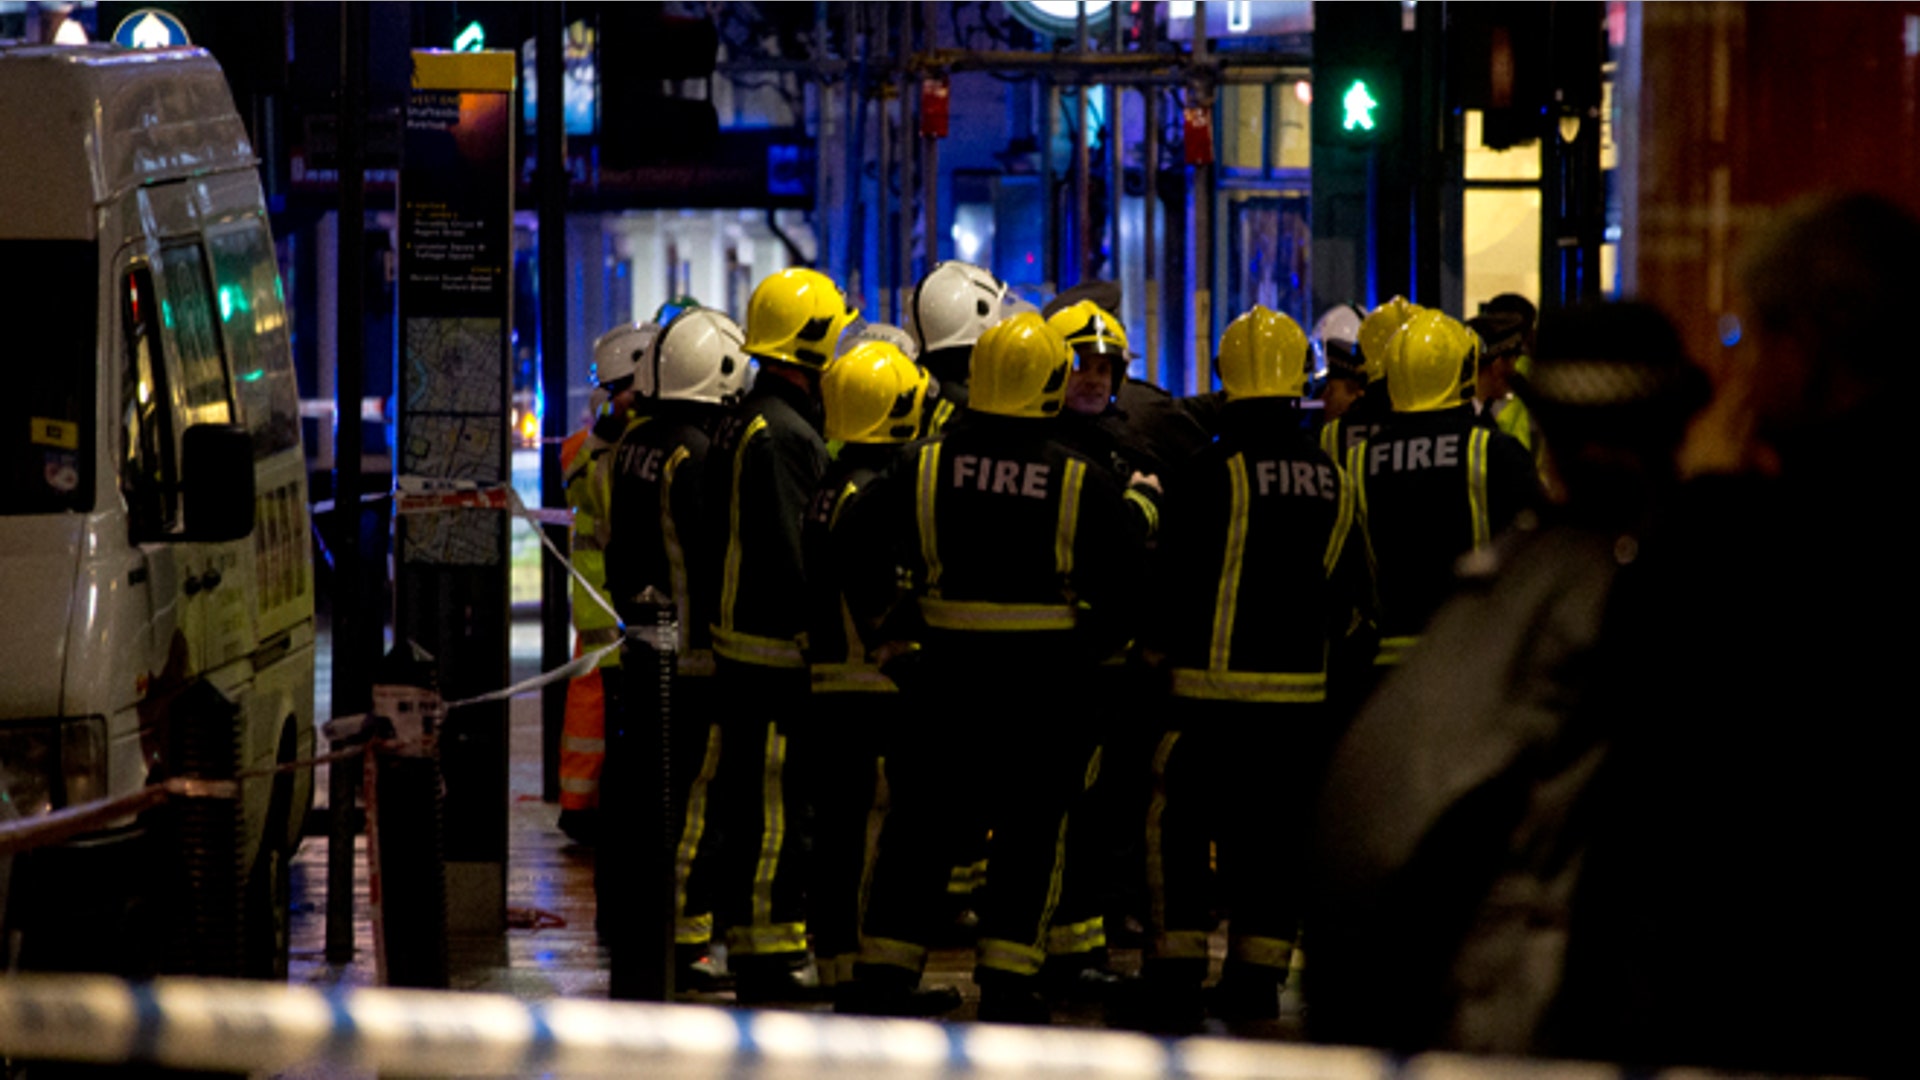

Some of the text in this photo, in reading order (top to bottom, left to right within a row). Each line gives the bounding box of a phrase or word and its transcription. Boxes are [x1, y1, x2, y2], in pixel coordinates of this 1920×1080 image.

[953, 453, 1051, 500] FIRE
[1369, 432, 1460, 478] FIRE
[1255, 458, 1337, 502] FIRE
